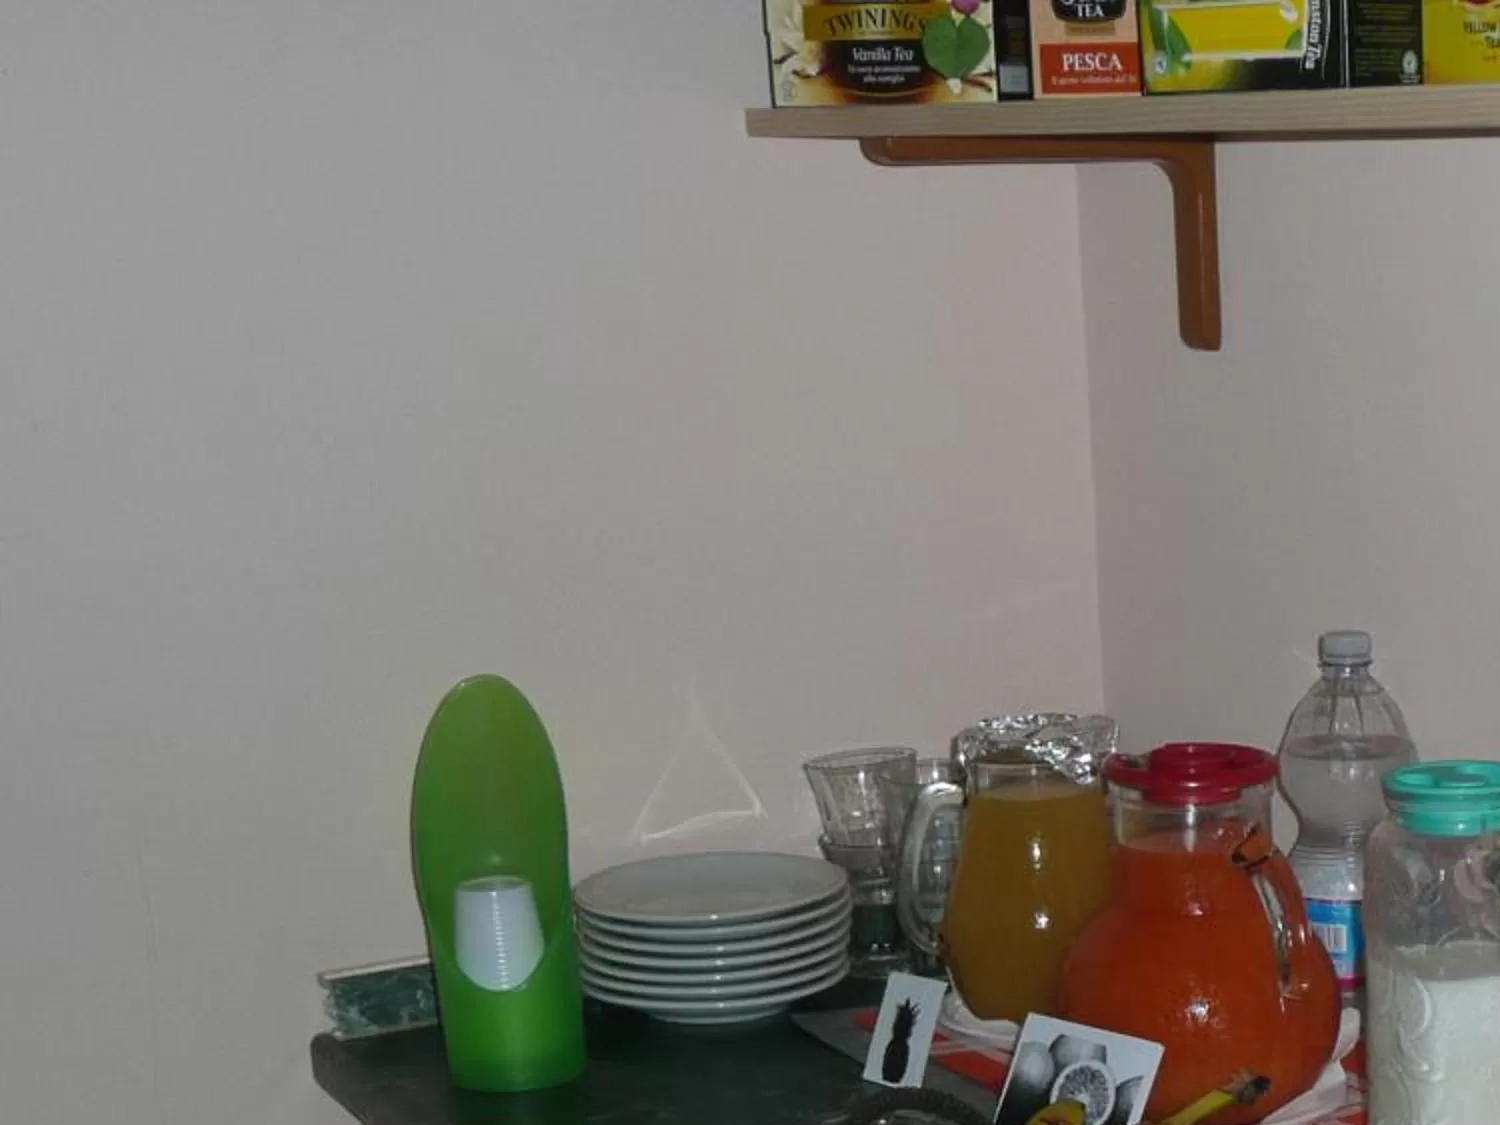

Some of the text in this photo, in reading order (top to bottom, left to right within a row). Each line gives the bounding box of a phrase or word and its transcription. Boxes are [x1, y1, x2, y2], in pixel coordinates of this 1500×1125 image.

[1077, 4, 1104, 17] TEA
[894, 46, 914, 61] Tea
[1062, 52, 1123, 71] PESCA
